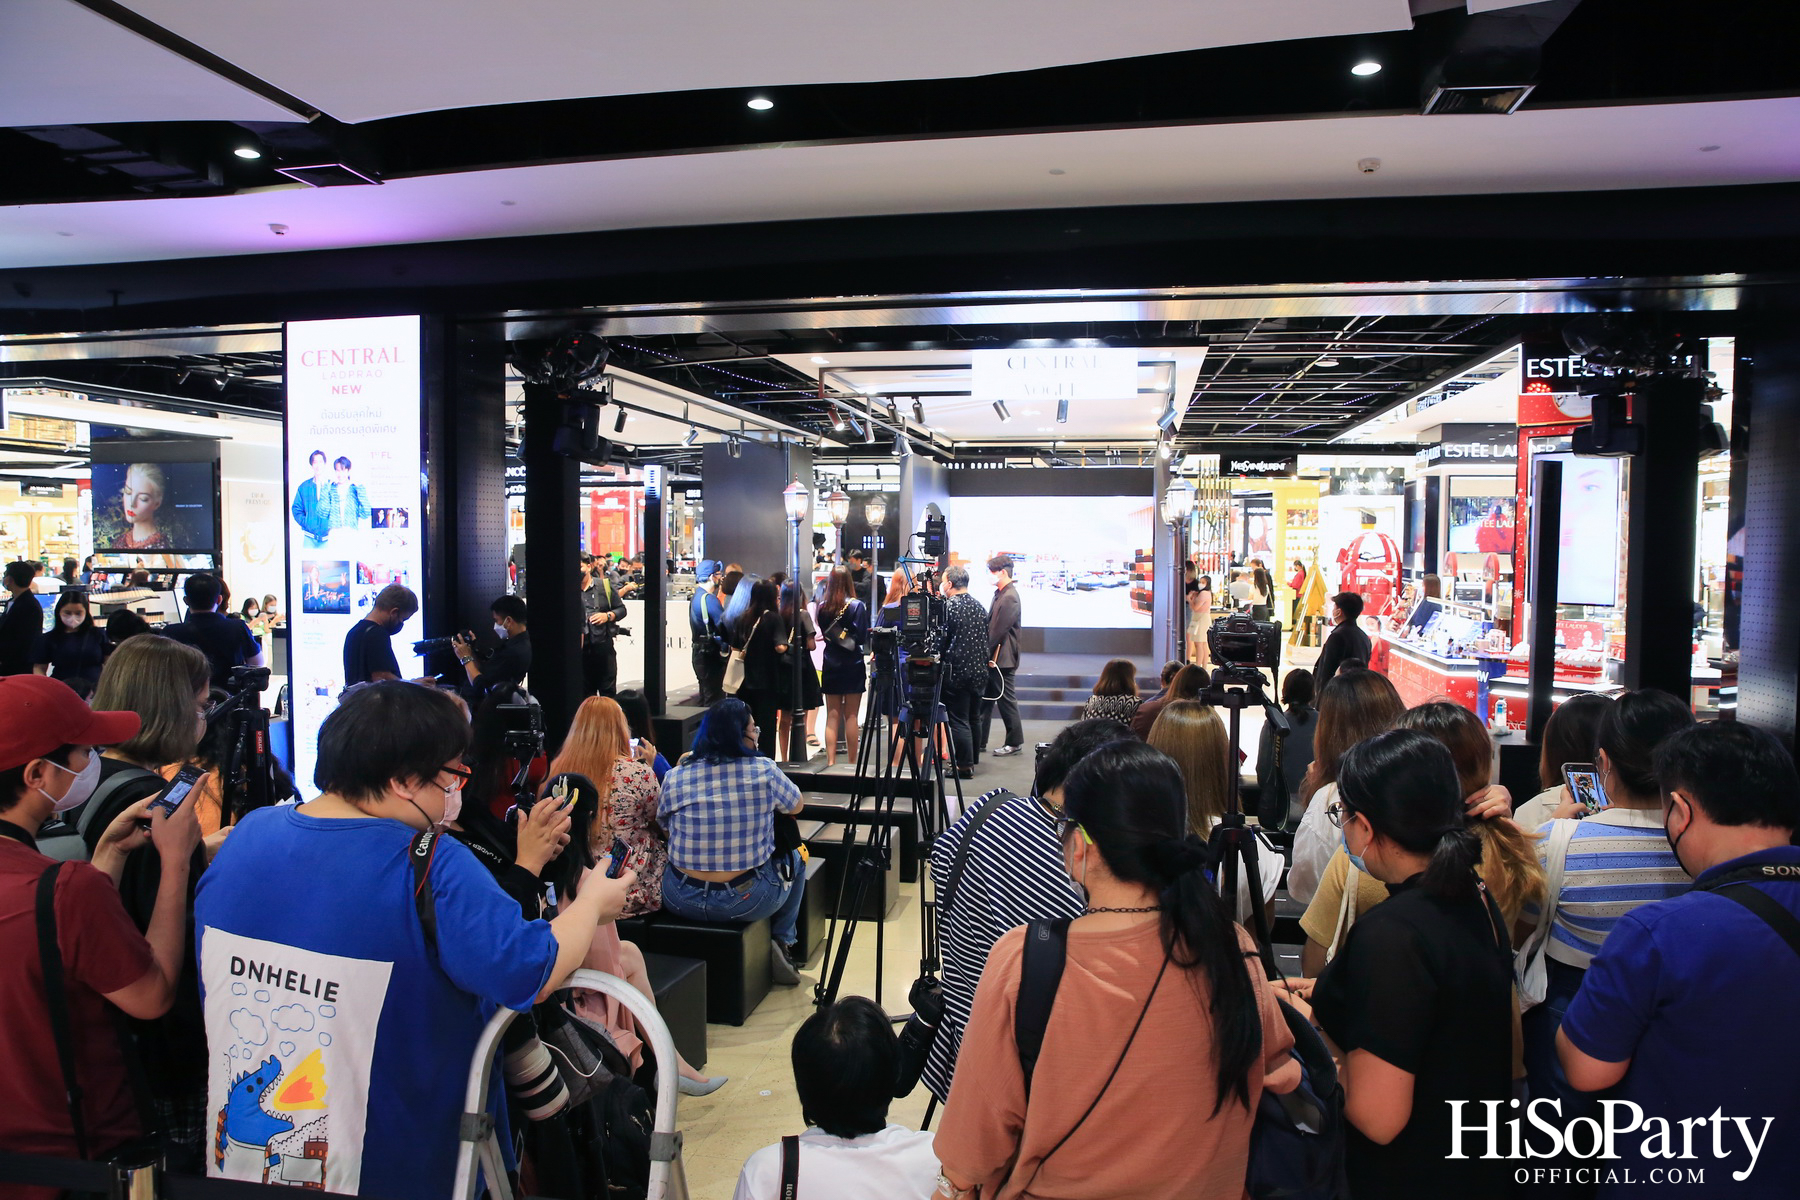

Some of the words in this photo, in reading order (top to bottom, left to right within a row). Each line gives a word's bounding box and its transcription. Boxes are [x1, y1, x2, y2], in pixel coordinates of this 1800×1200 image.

[301, 346, 405, 367] CENTRAL
[322, 369, 383, 380] LADPRAO
[331, 385, 362, 395] NEW
[229, 955, 341, 1003] DNHELIE
